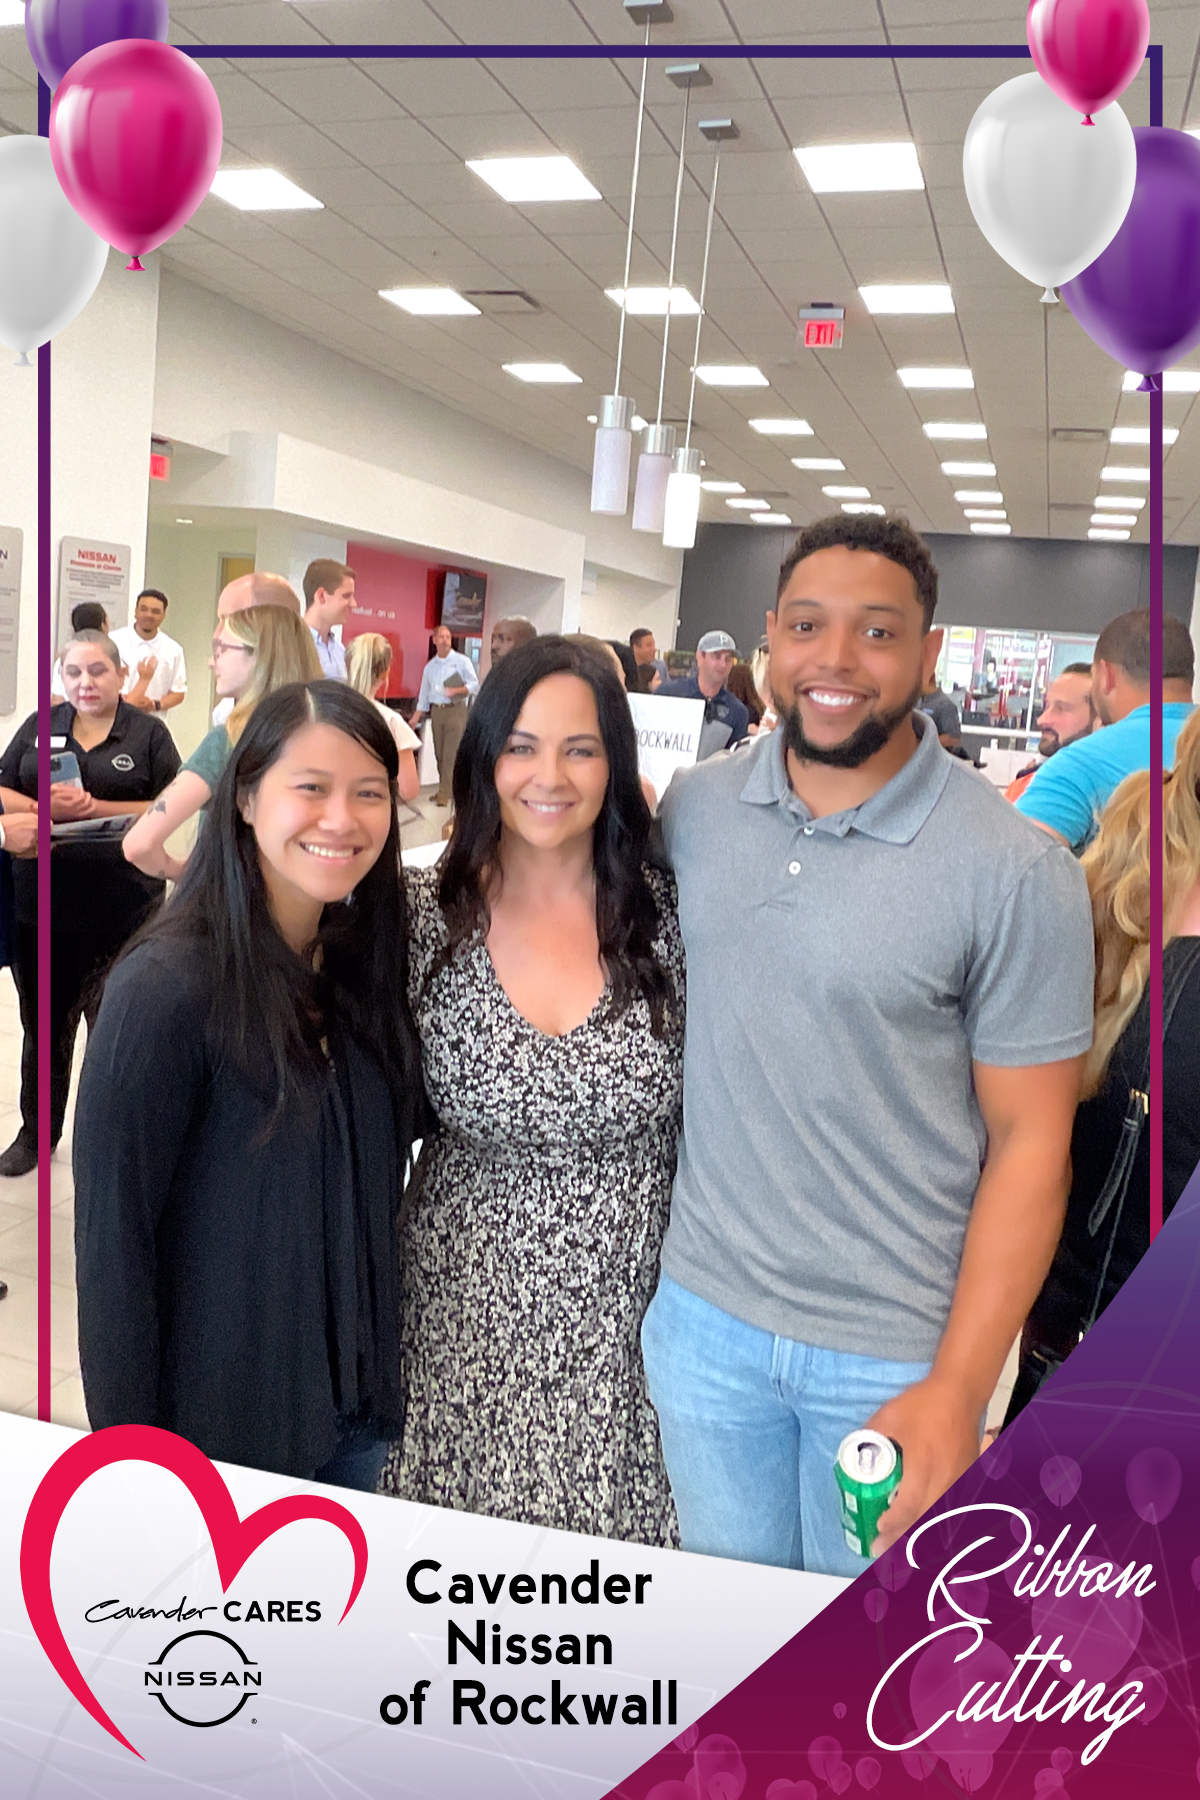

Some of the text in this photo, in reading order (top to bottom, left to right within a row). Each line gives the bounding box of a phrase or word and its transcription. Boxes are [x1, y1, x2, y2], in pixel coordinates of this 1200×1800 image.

[805, 321, 836, 346] EXIT
[77, 549, 117, 564] NISSAN
[635, 729, 692, 752] ROCKWALL
